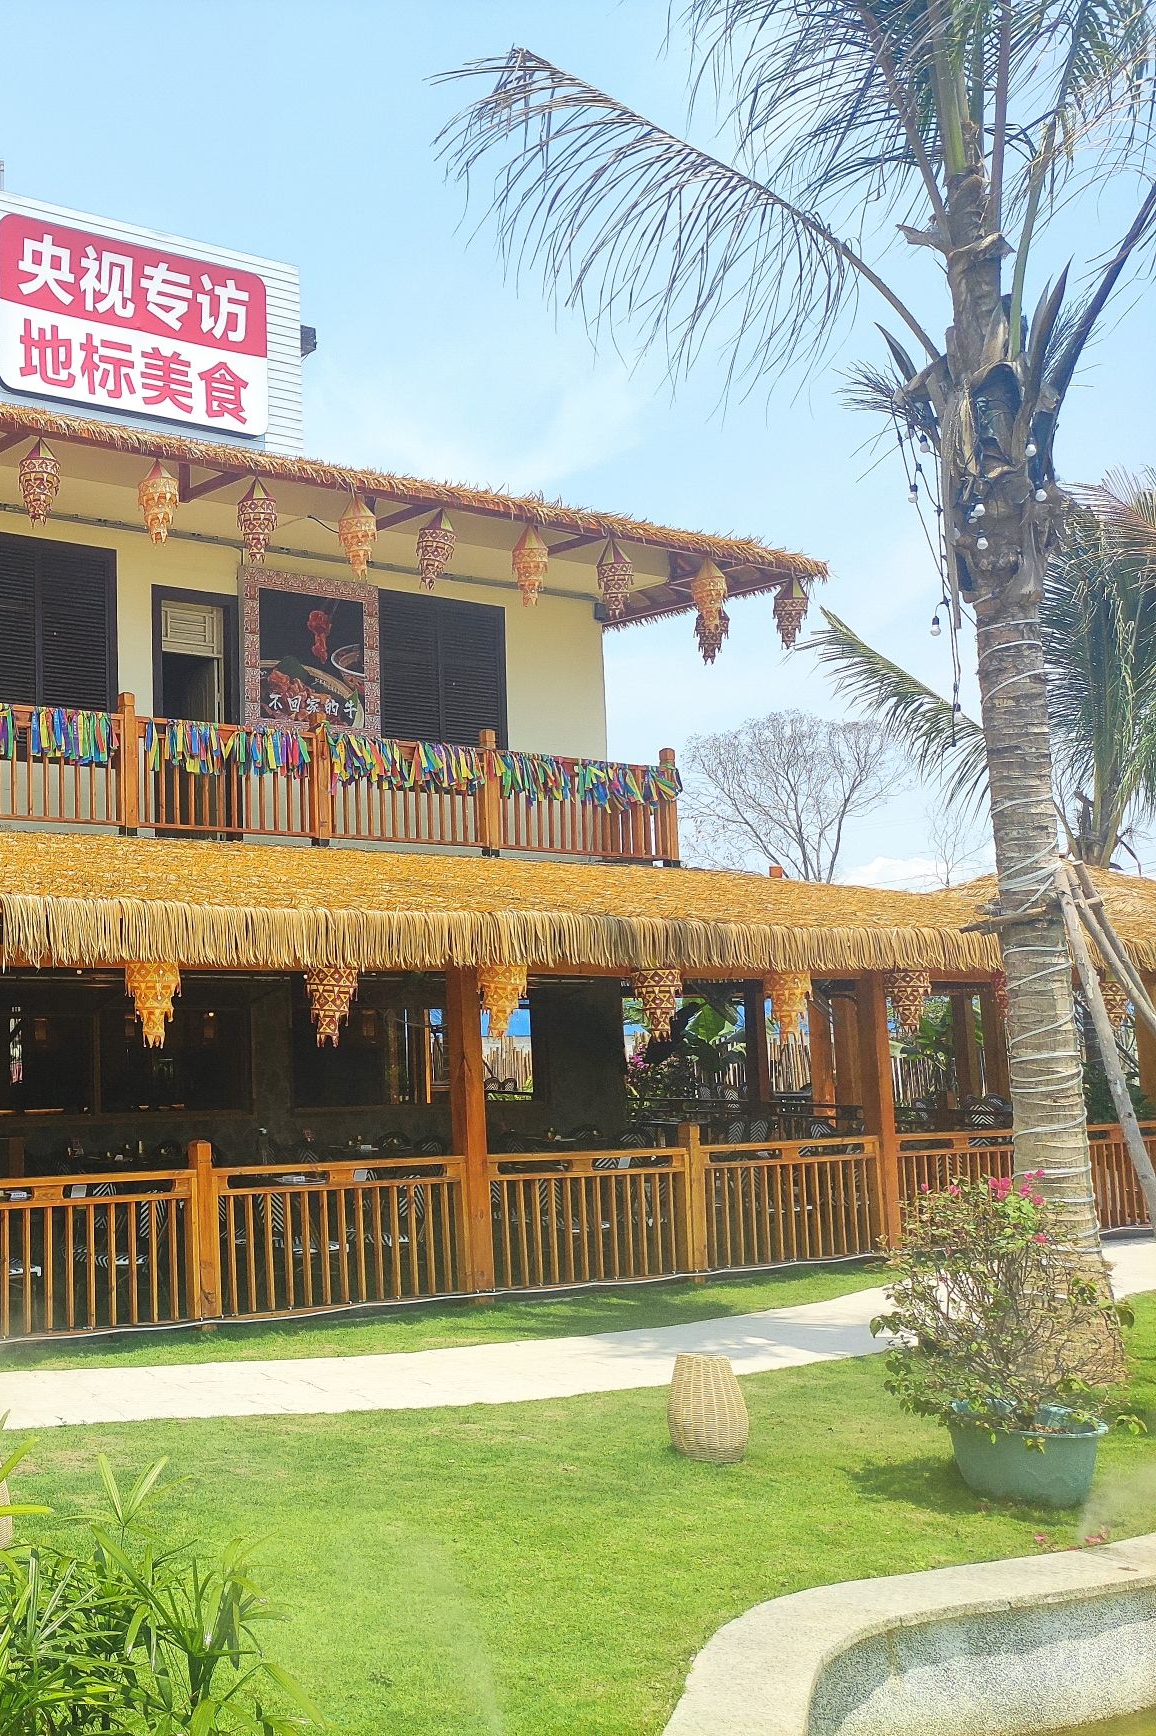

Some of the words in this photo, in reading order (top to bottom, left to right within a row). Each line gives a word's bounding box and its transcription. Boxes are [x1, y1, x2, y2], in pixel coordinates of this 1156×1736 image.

[18, 233, 250, 343] 央视专访
[19, 318, 249, 425] 地标美食
[268, 694, 358, 719] 不回家的牛
